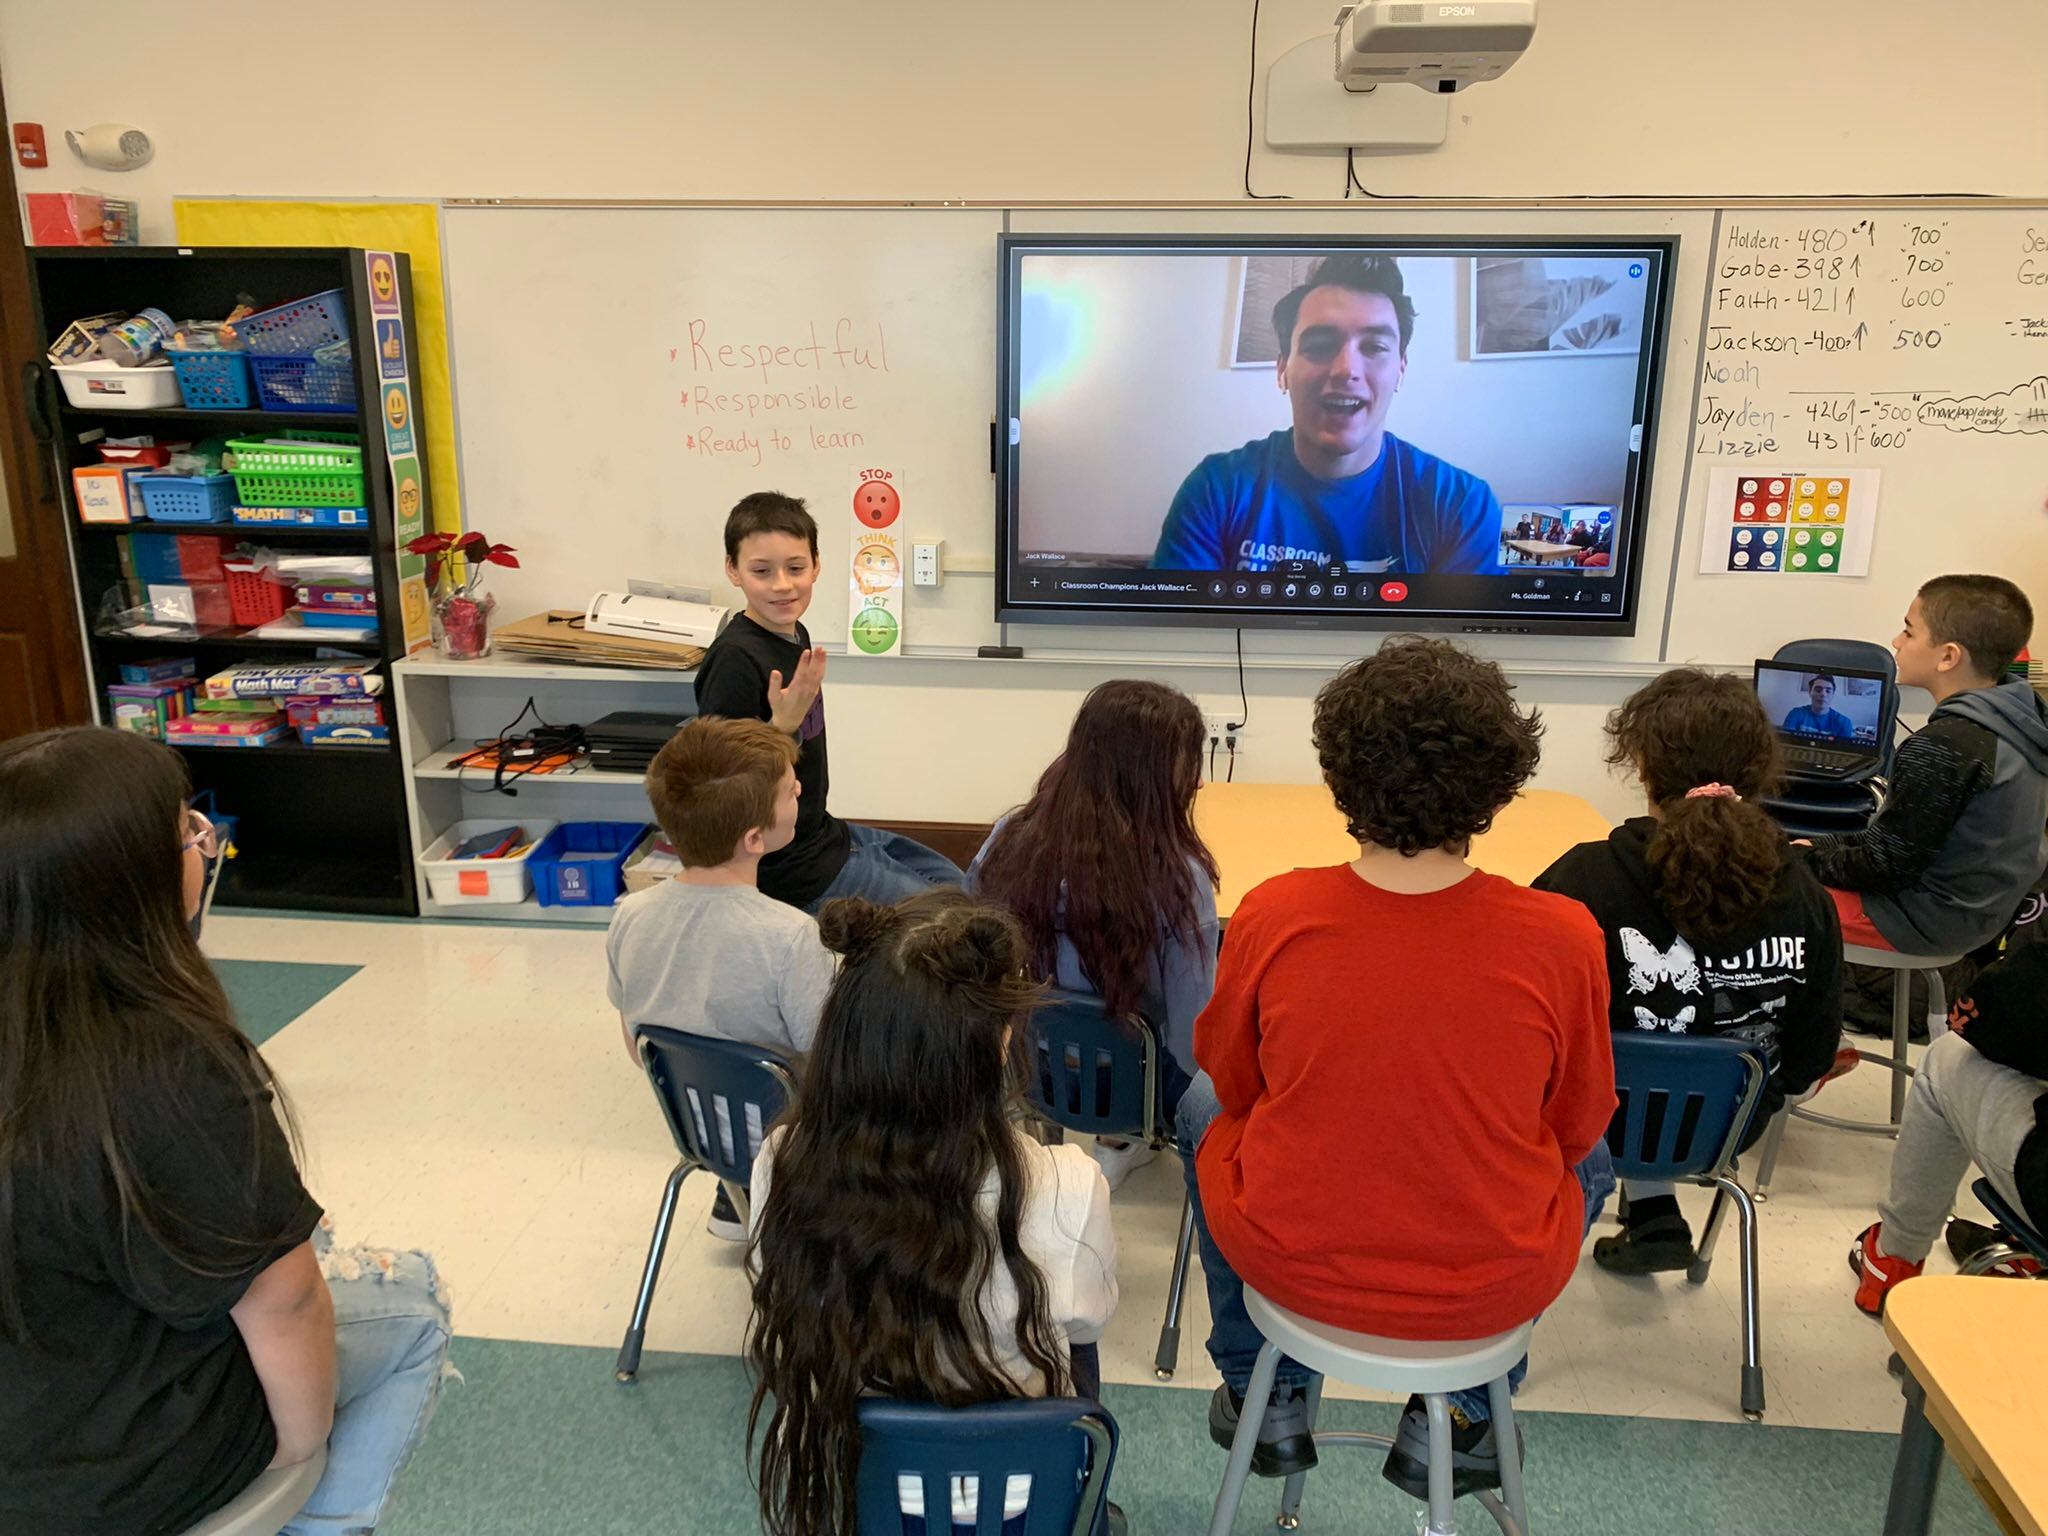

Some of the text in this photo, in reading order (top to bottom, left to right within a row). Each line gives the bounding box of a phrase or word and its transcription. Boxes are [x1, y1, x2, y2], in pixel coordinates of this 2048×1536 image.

[1439, 6, 1475, 17] EPSON
[1797, 228, 1848, 253] 480
[1794, 256, 1843, 280] 398
[1797, 287, 1838, 312] 421
[688, 317, 889, 385] Respectful
[1706, 326, 1799, 355] Jackson
[1704, 360, 1760, 390] Noah
[694, 383, 858, 418] Responsible
[1698, 396, 1774, 432] Jayden
[1806, 400, 1848, 422] 426
[699, 424, 865, 468] Ready to learn
[1697, 432, 1780, 457] Lizzie
[1808, 430, 1850, 453] 431
[859, 468, 893, 481] STOP
[857, 533, 898, 548] THINK
[1025, 552, 1040, 560] Jack
[1239, 539, 1332, 568] CLASSROOM
[1061, 581, 1098, 590] Classroom
[1099, 582, 1139, 592] Champions
[1139, 583, 1156, 591] Jack
[1157, 583, 1185, 592] Wallace
[864, 596, 889, 608] ACT
[236, 679, 269, 692] Math
[271, 678, 298, 690] Mat
